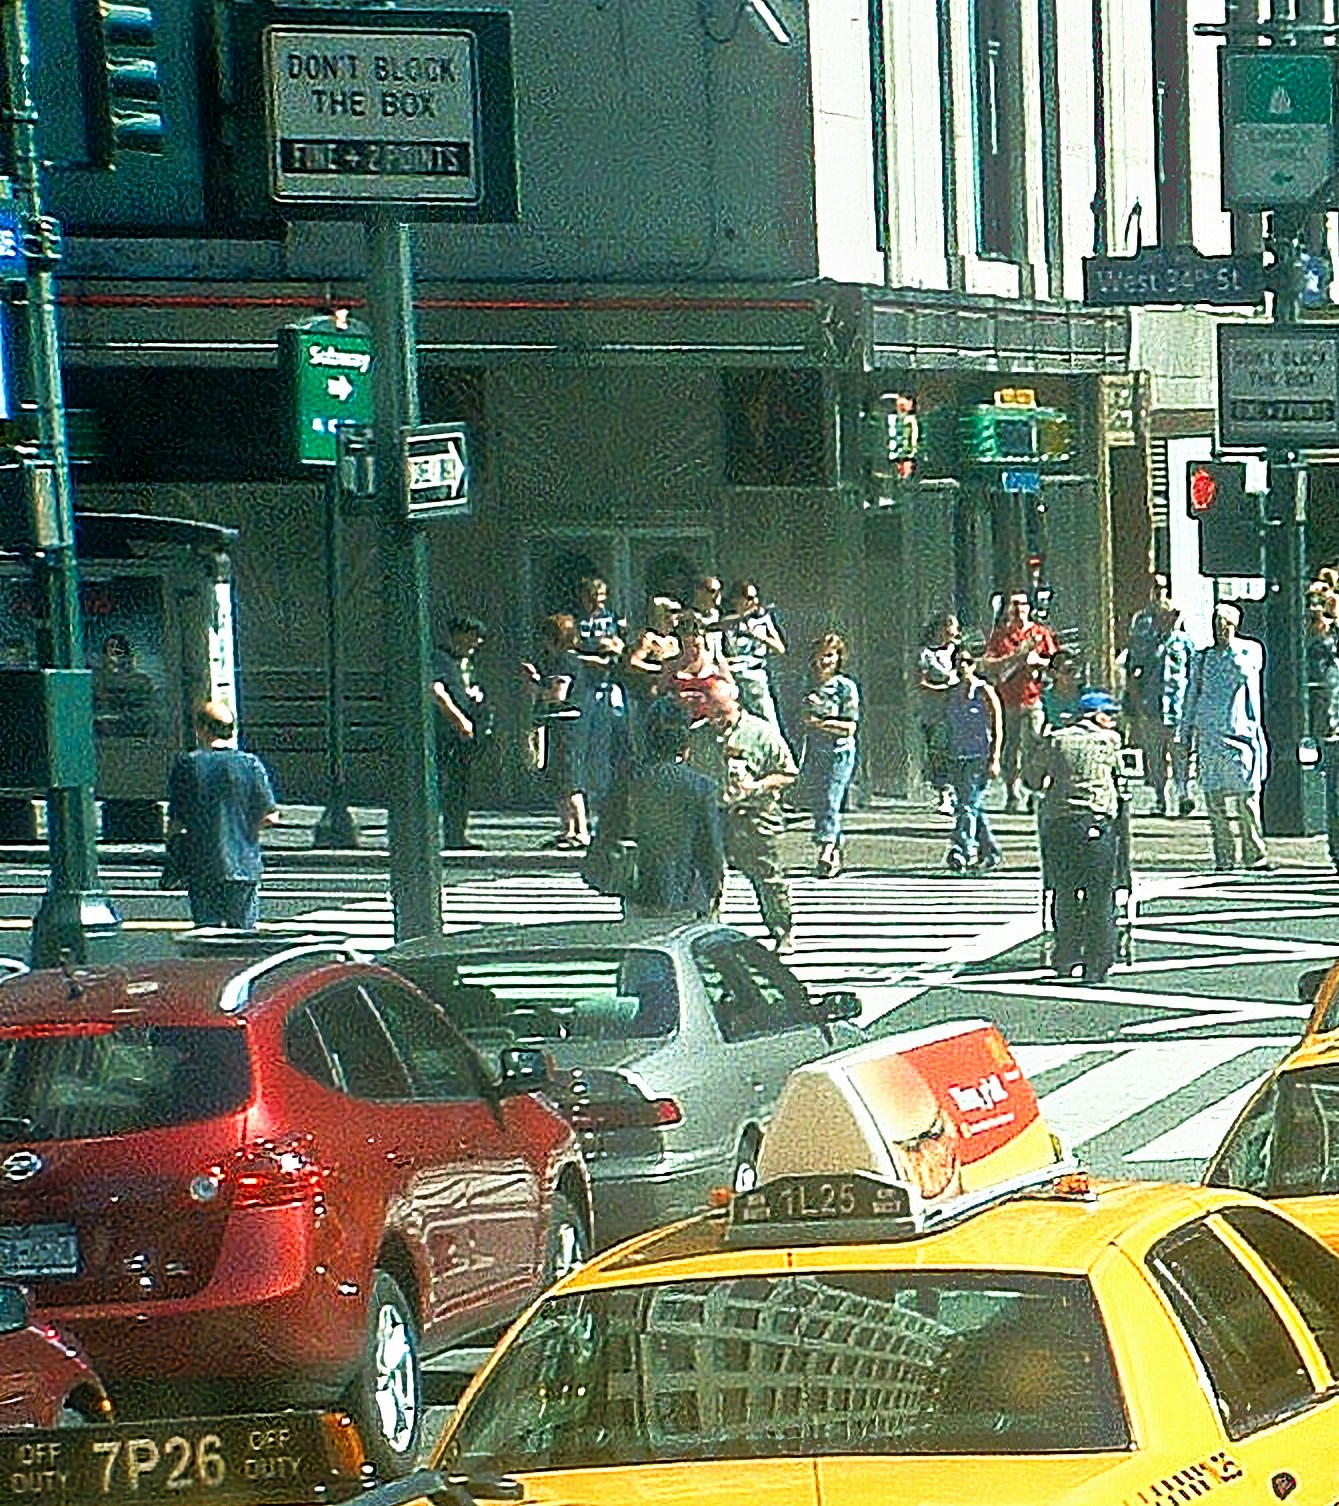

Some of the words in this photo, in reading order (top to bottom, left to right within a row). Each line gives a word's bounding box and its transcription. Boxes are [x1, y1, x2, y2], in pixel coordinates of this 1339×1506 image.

[288, 53, 359, 80] DON'T
[374, 55, 456, 83] BLOCK
[311, 89, 366, 116] THE
[381, 91, 435, 118] BOX
[780, 1183, 856, 1217] 1L25
[92, 1433, 225, 1494] 7P26
